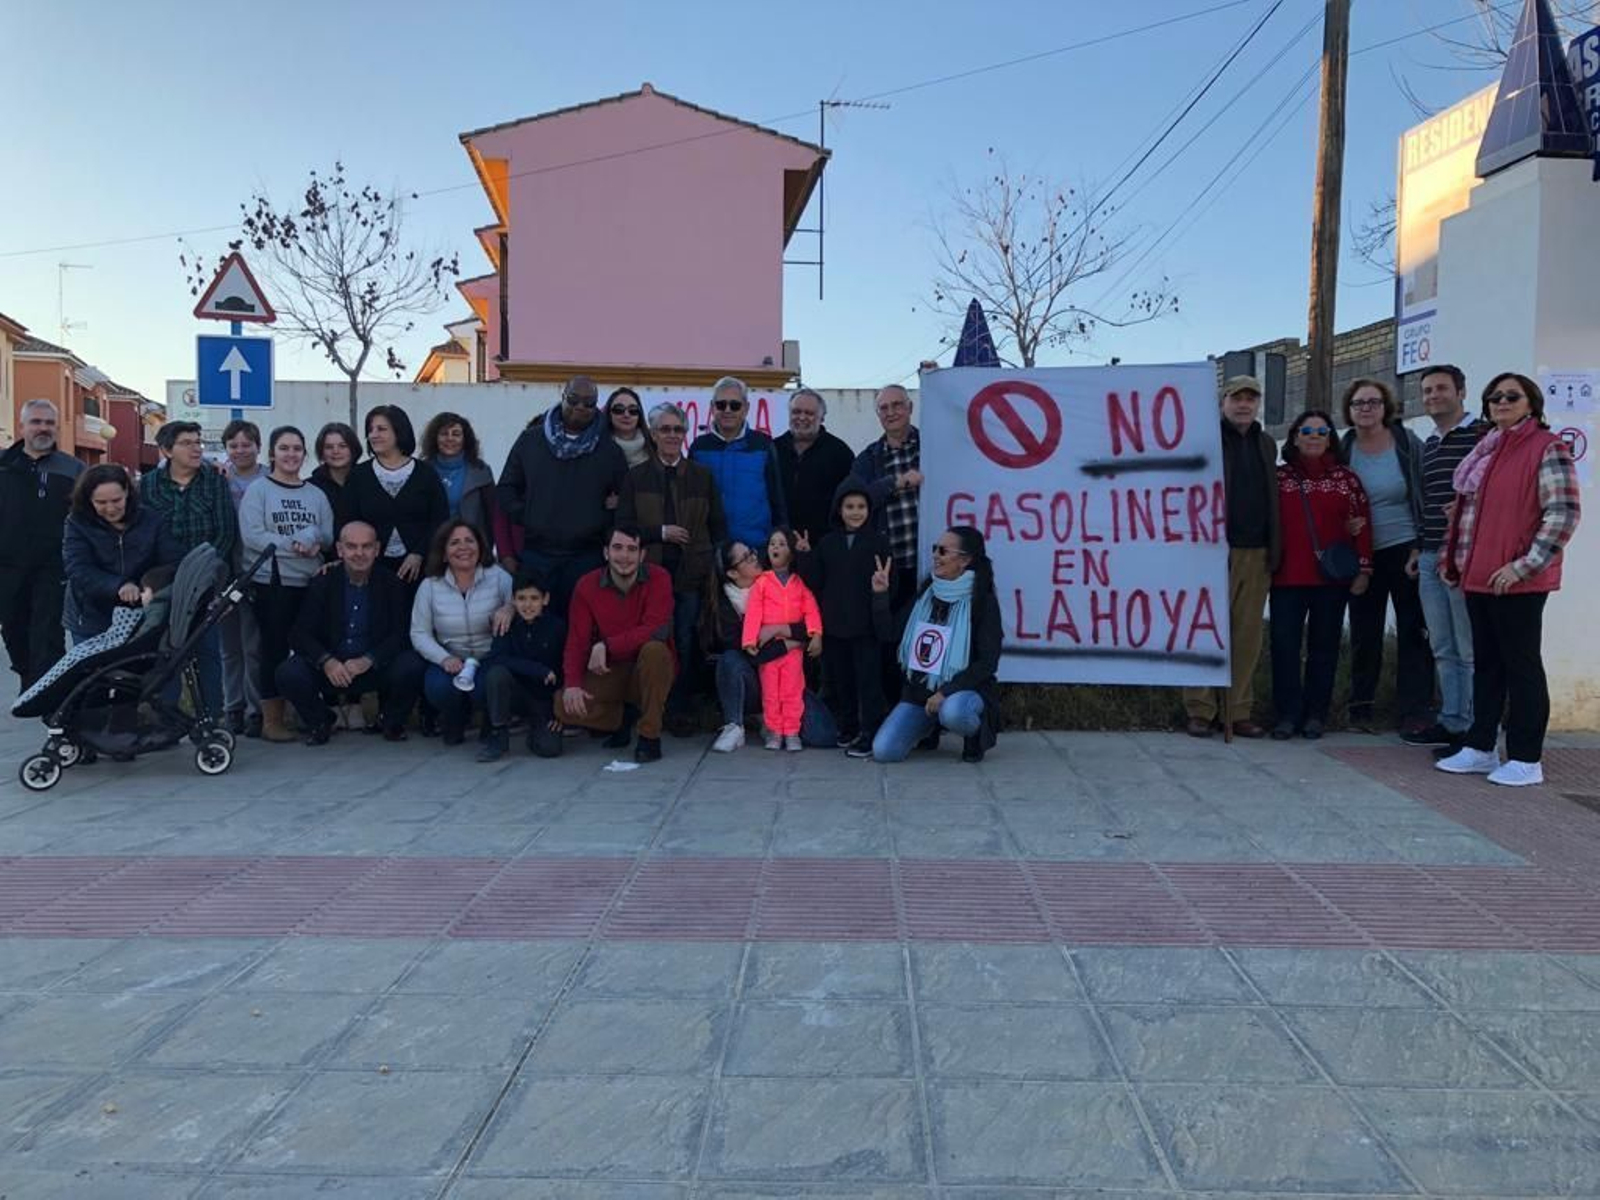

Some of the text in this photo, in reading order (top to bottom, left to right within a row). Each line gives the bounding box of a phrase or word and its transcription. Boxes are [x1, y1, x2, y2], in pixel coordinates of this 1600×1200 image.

[1403, 337, 1430, 366] FEQ
[1107, 386, 1185, 456] NO
[946, 474, 1226, 544] GASOLINERA
[1053, 549, 1110, 586] EN
